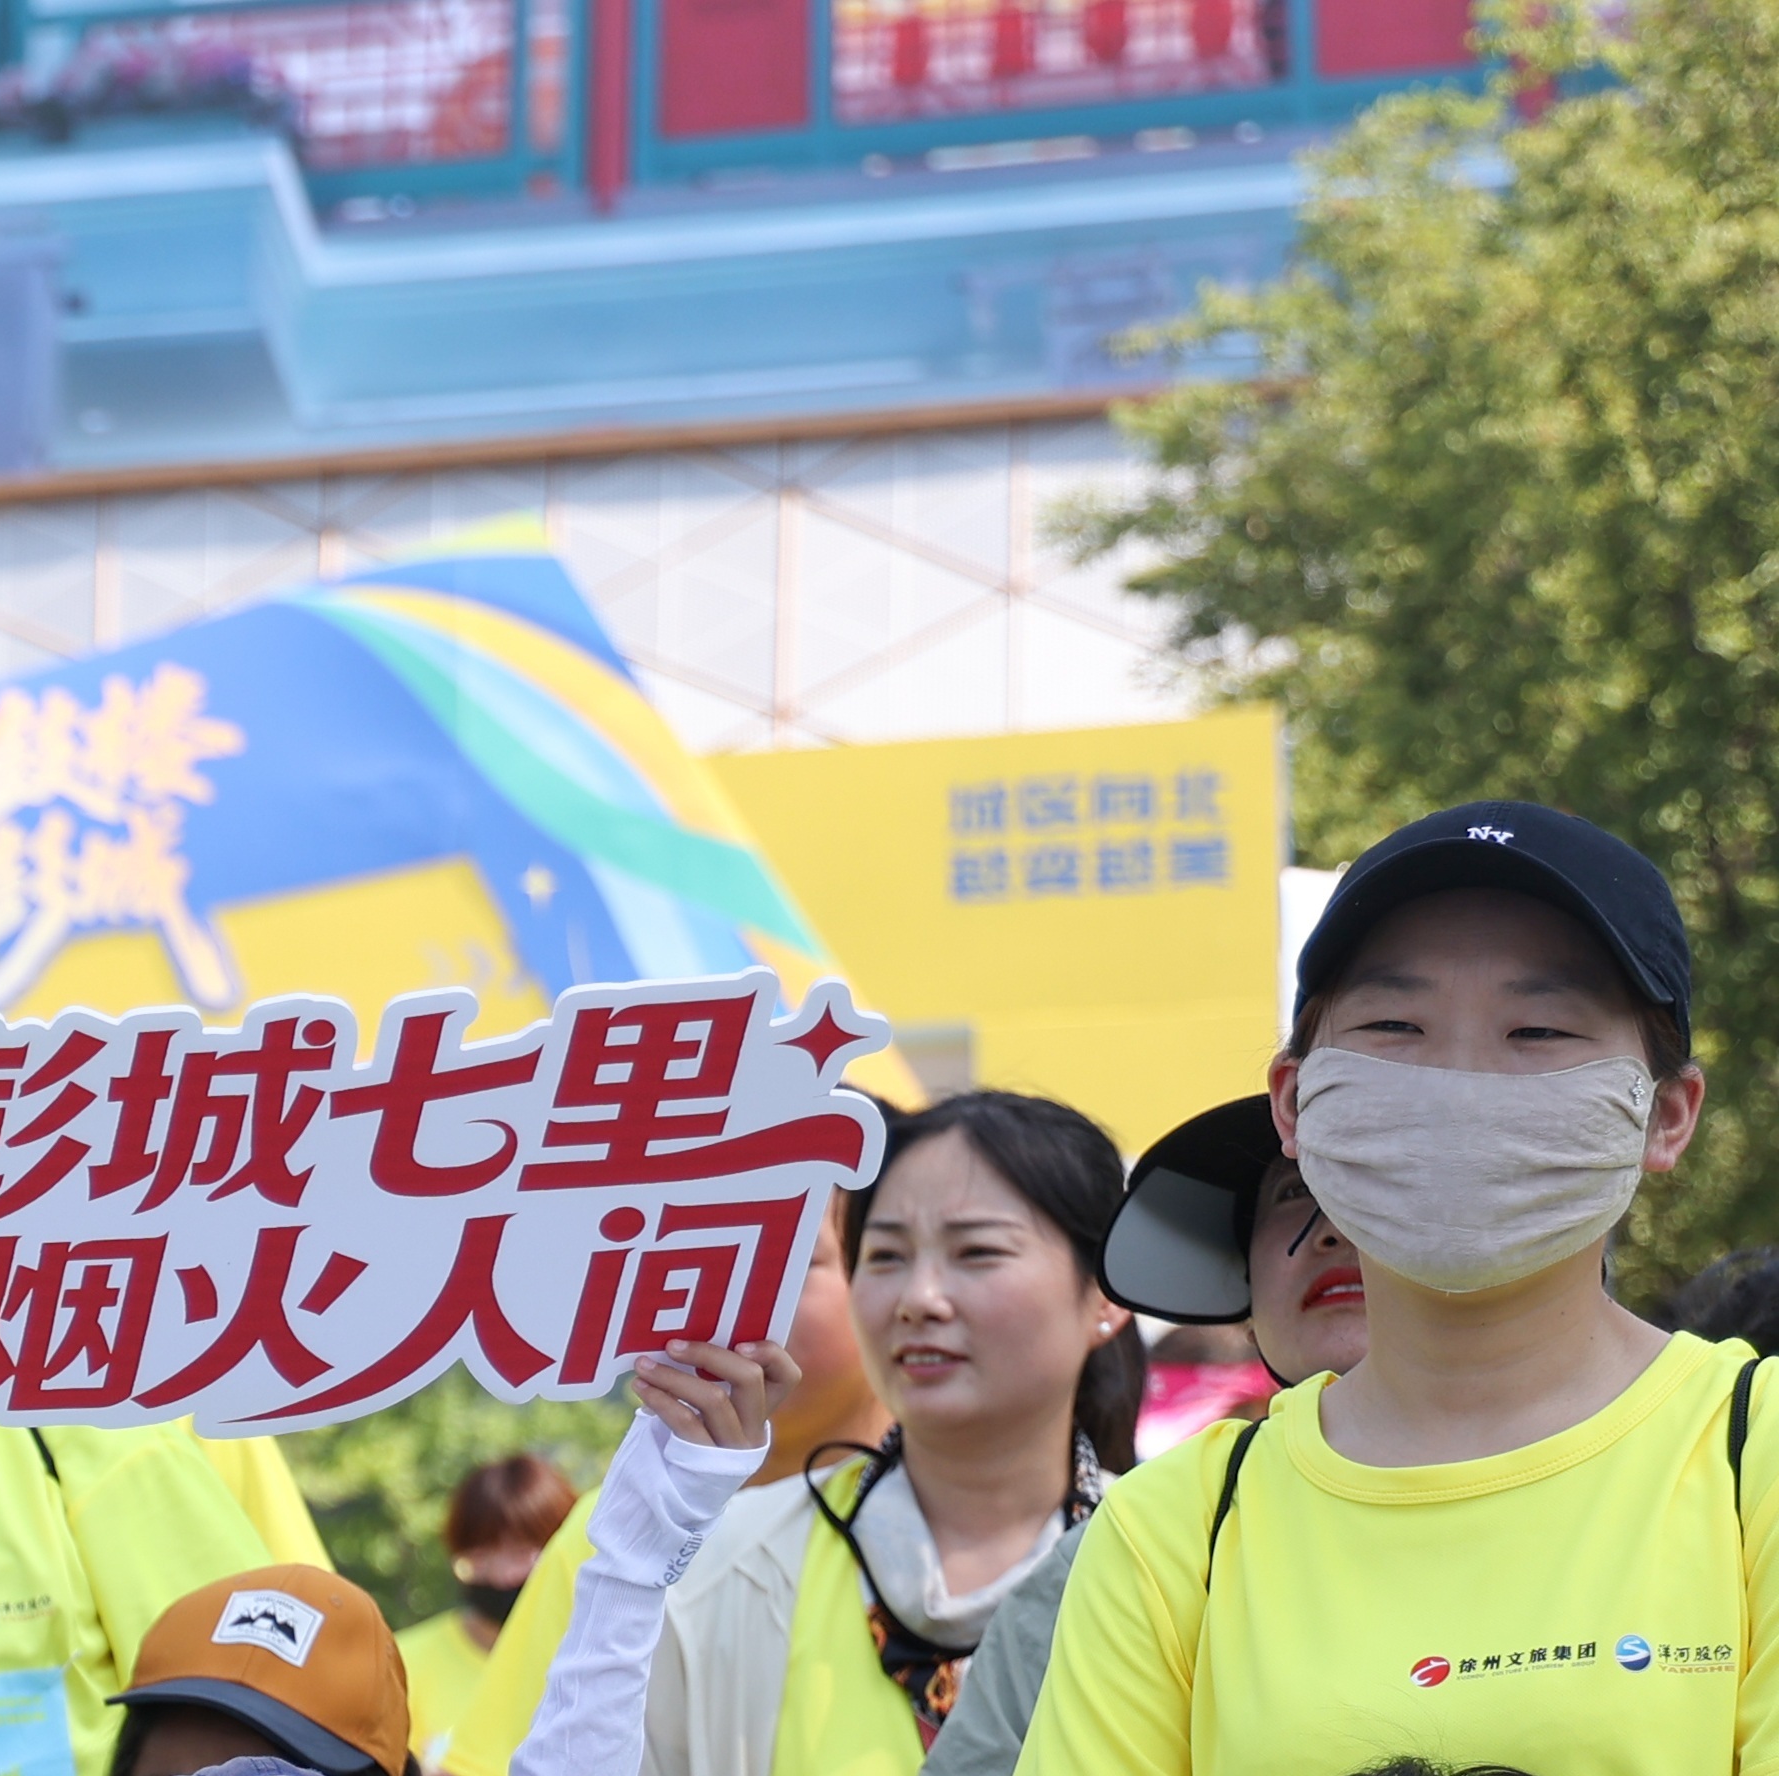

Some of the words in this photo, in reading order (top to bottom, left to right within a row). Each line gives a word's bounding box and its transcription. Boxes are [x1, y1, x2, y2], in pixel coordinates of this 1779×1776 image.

[1467, 825, 1514, 845] NY
[1459, 1640, 1597, 1675] 徐州文旅集团
[1657, 1643, 1734, 1663] 洋河股份
[1657, 1663, 1736, 1675] YANGHE
